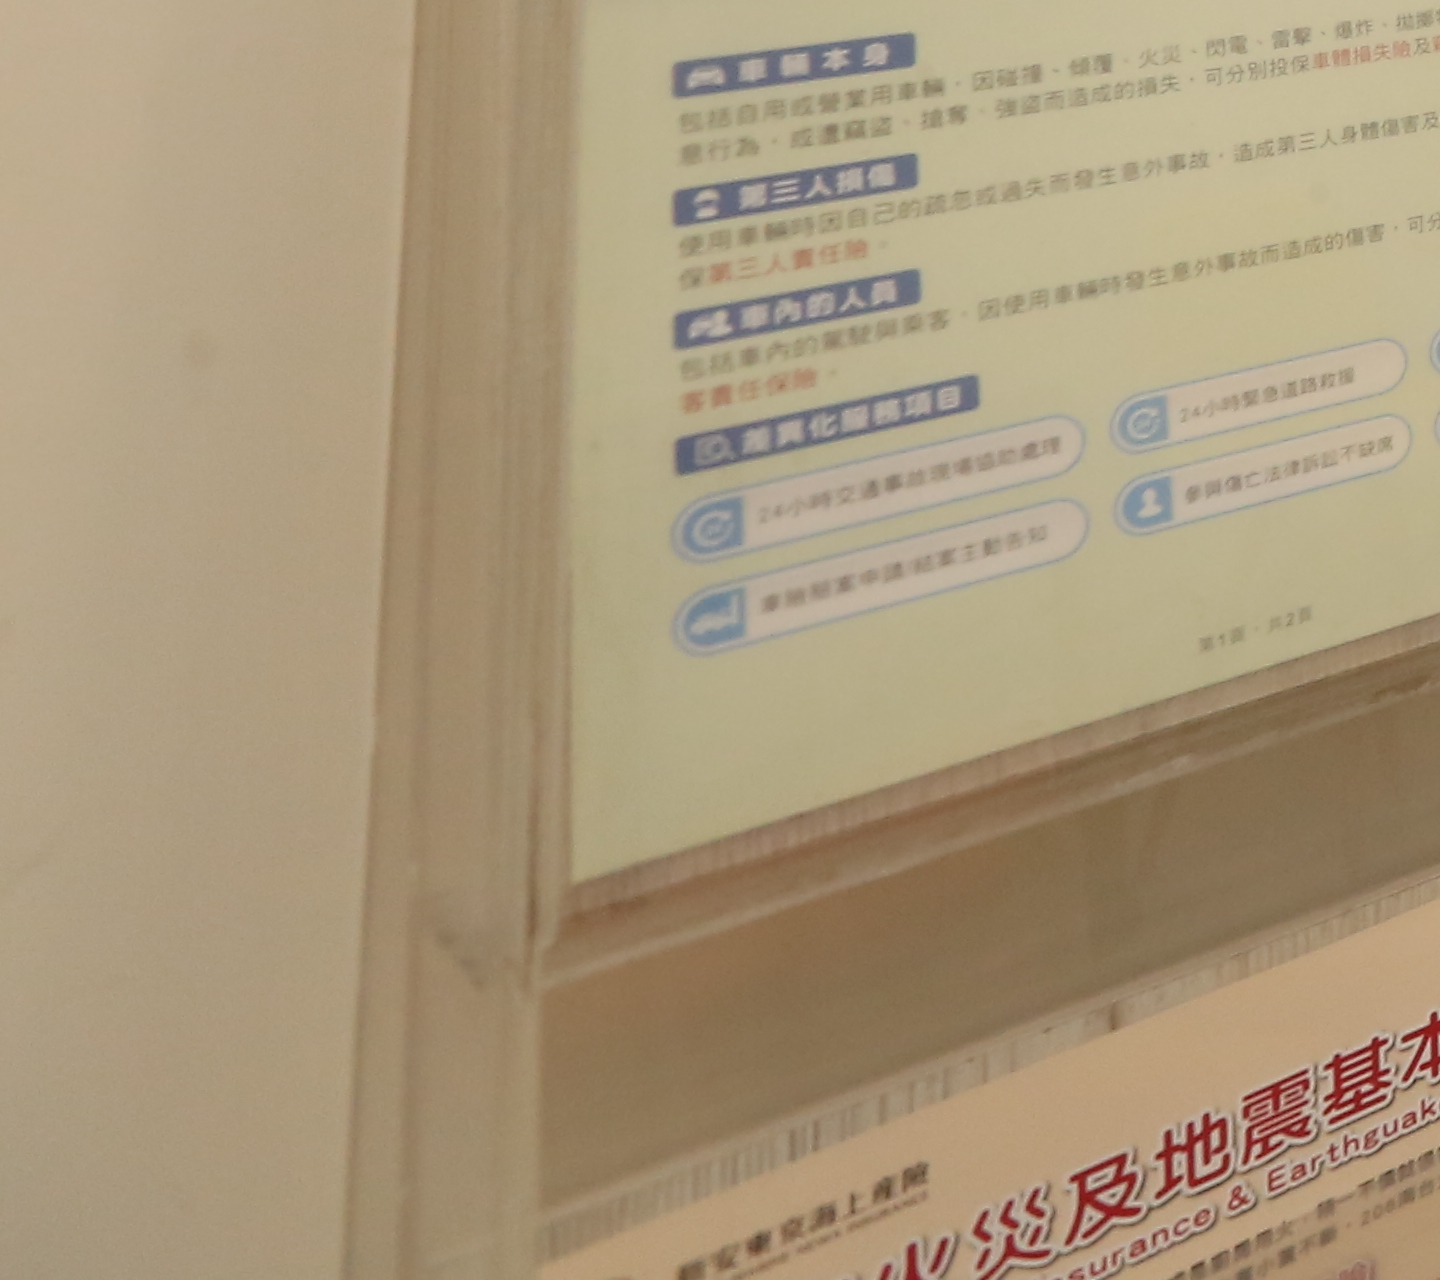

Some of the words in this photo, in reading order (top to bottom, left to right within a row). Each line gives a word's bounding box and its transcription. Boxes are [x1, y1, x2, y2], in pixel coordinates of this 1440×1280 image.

[736, 41, 892, 85] 車輛本身
[739, 276, 899, 332] 車內的人員
[741, 384, 963, 456] 差異化服務項目
[1179, 365, 1357, 425] 24小時緊急道路救援
[1226, 1186, 1256, 1229] &
